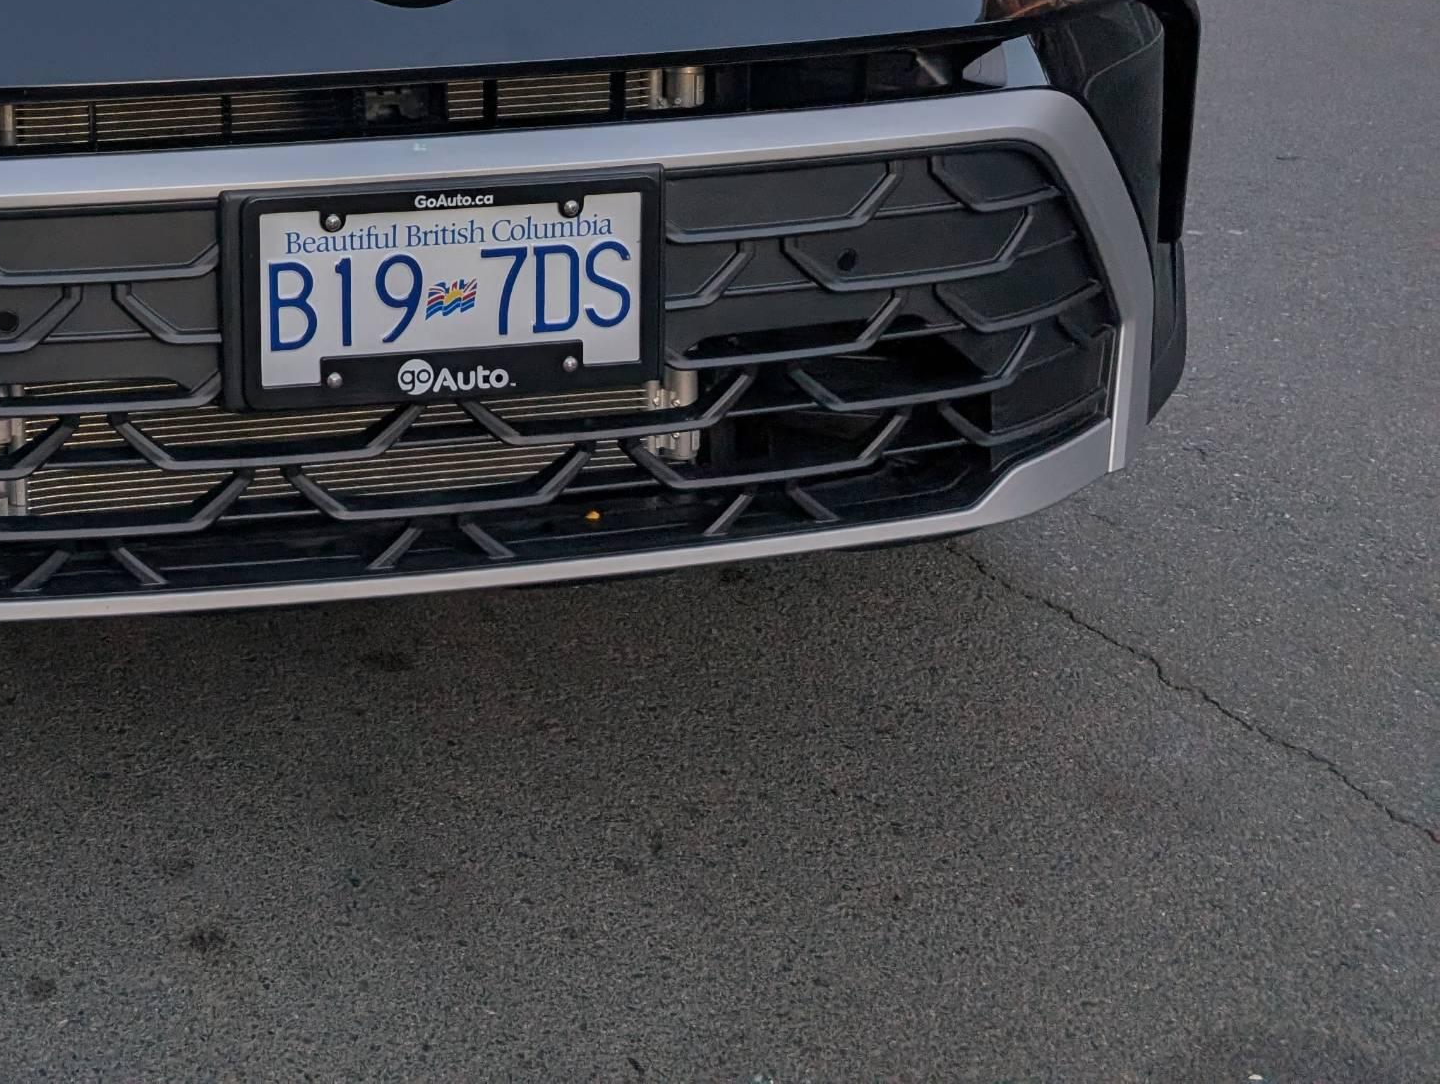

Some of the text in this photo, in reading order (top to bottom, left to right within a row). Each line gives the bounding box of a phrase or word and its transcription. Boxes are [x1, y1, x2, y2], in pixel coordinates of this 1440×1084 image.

[414, 193, 494, 209] GoAuto.ca
[284, 214, 613, 256] Beautiful British Columbia
